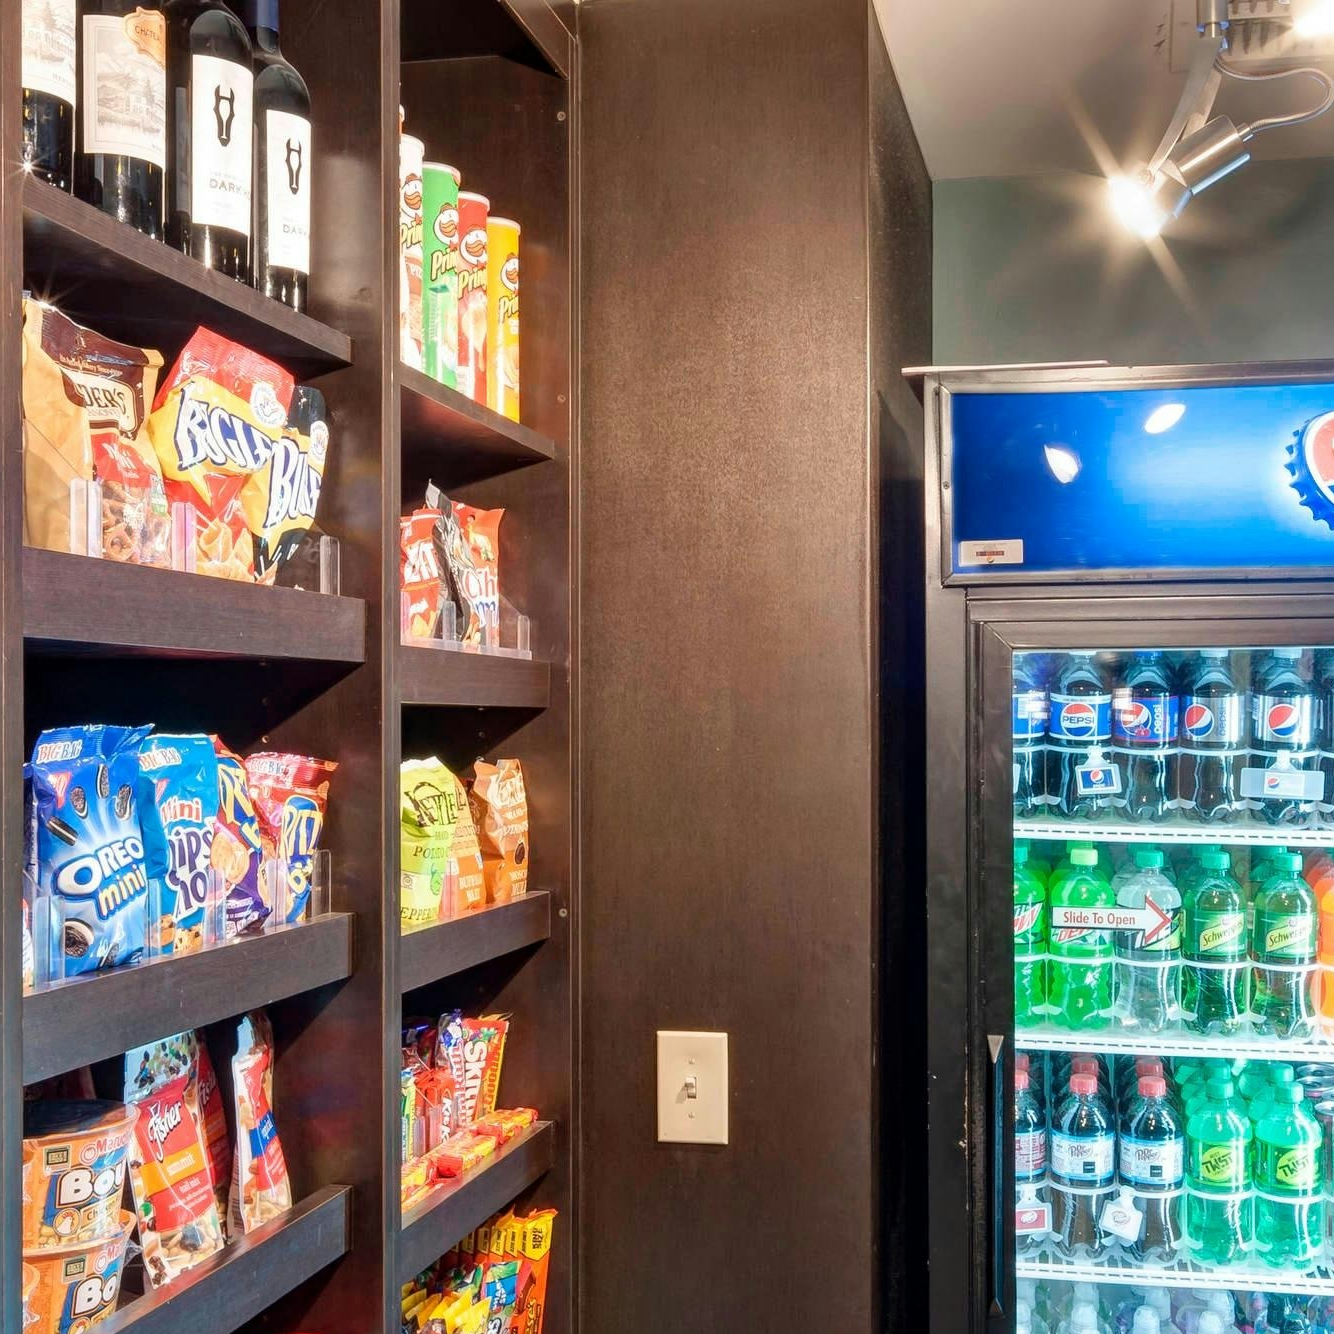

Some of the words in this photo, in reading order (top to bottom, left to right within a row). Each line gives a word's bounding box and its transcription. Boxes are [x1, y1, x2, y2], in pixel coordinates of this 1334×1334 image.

[38, 743, 62, 764] BIG
[57, 836, 145, 895] OREO
[98, 863, 147, 917] mini
[1063, 911, 1089, 924] Slide
[1093, 912, 1104, 924] To
[1107, 913, 1136, 926] Open
